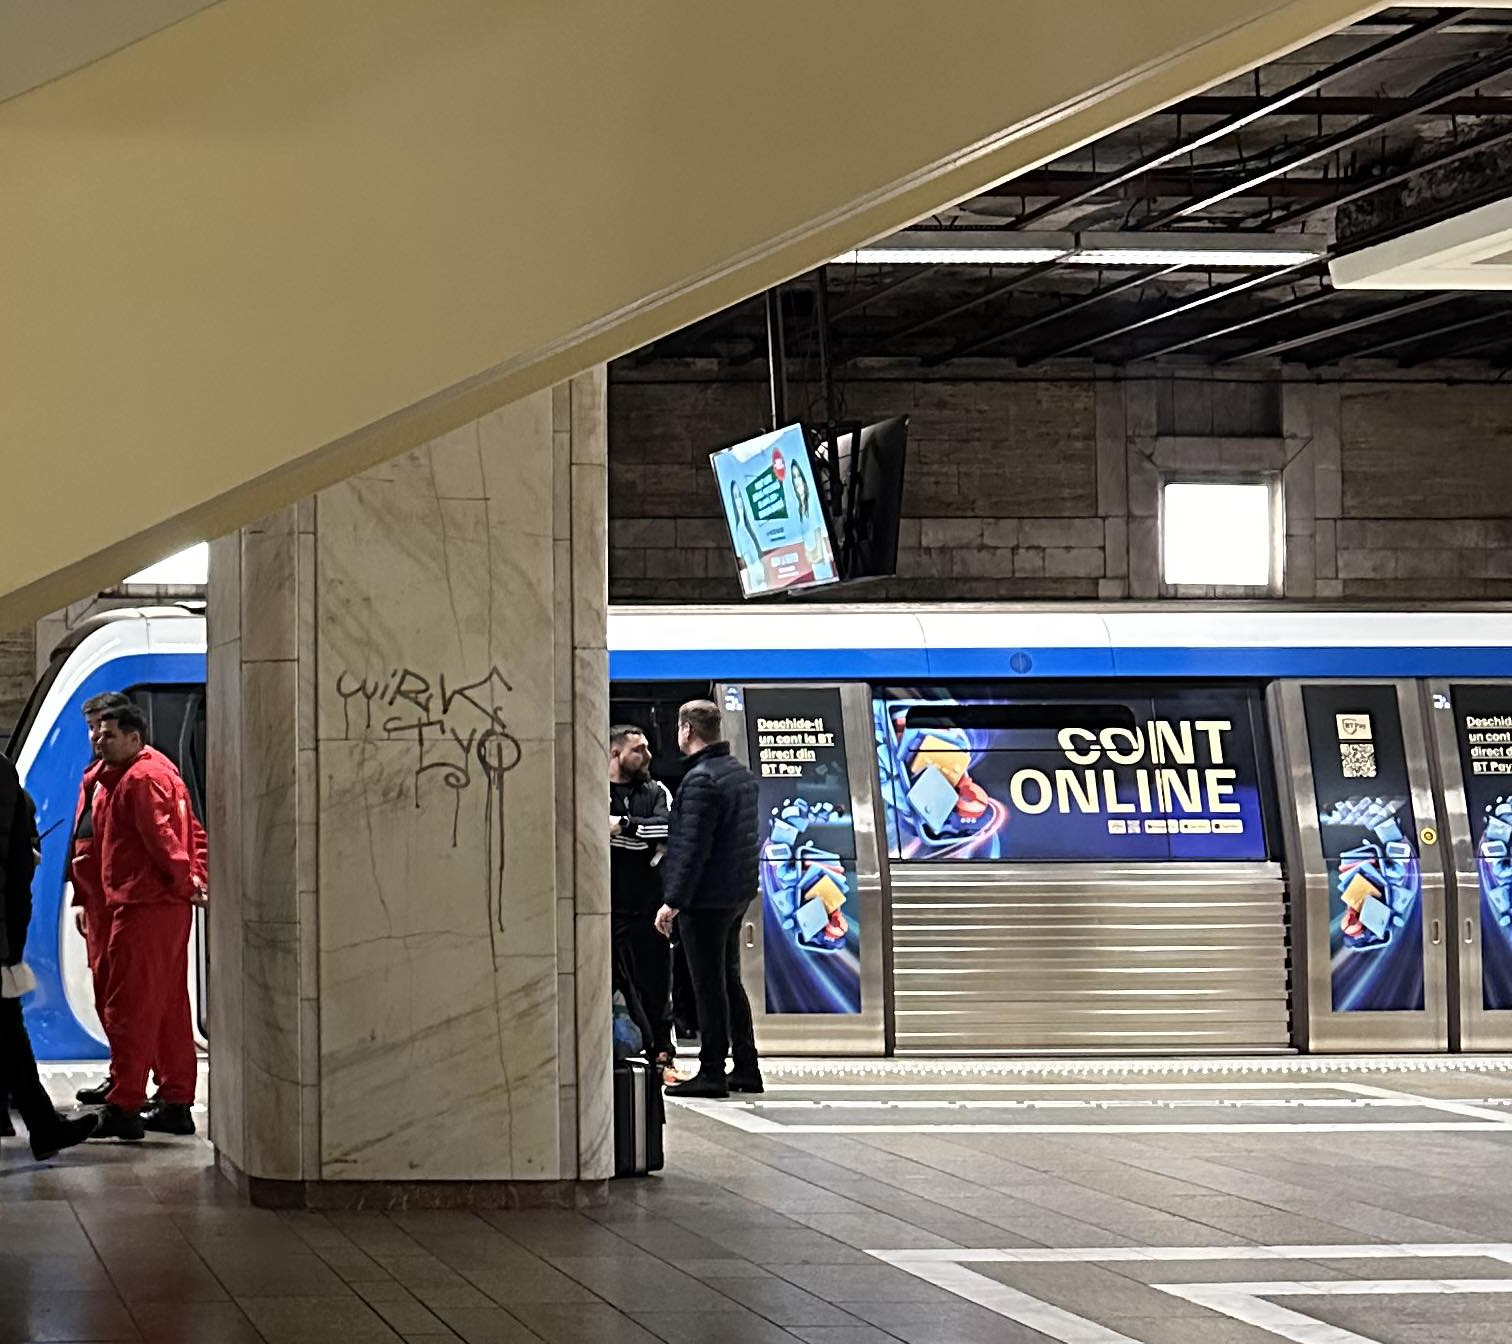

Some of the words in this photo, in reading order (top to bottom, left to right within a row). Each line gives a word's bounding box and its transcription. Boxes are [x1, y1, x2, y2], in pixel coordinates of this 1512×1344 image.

[1466, 716, 1512, 727] Deschid
[758, 735, 774, 745] un
[775, 733, 803, 745] cont
[803, 733, 816, 745] la
[817, 733, 834, 744] BT
[1057, 720, 1232, 765] CONT
[1468, 732, 1483, 742] un
[1485, 731, 1511, 742] cont
[759, 748, 794, 760] direct
[795, 748, 816, 760] din
[1470, 746, 1504, 757] direct
[761, 763, 777, 774] BT
[778, 763, 803, 776] Pay
[1472, 761, 1488, 772] BT
[1010, 768, 1241, 814] ONLINE
